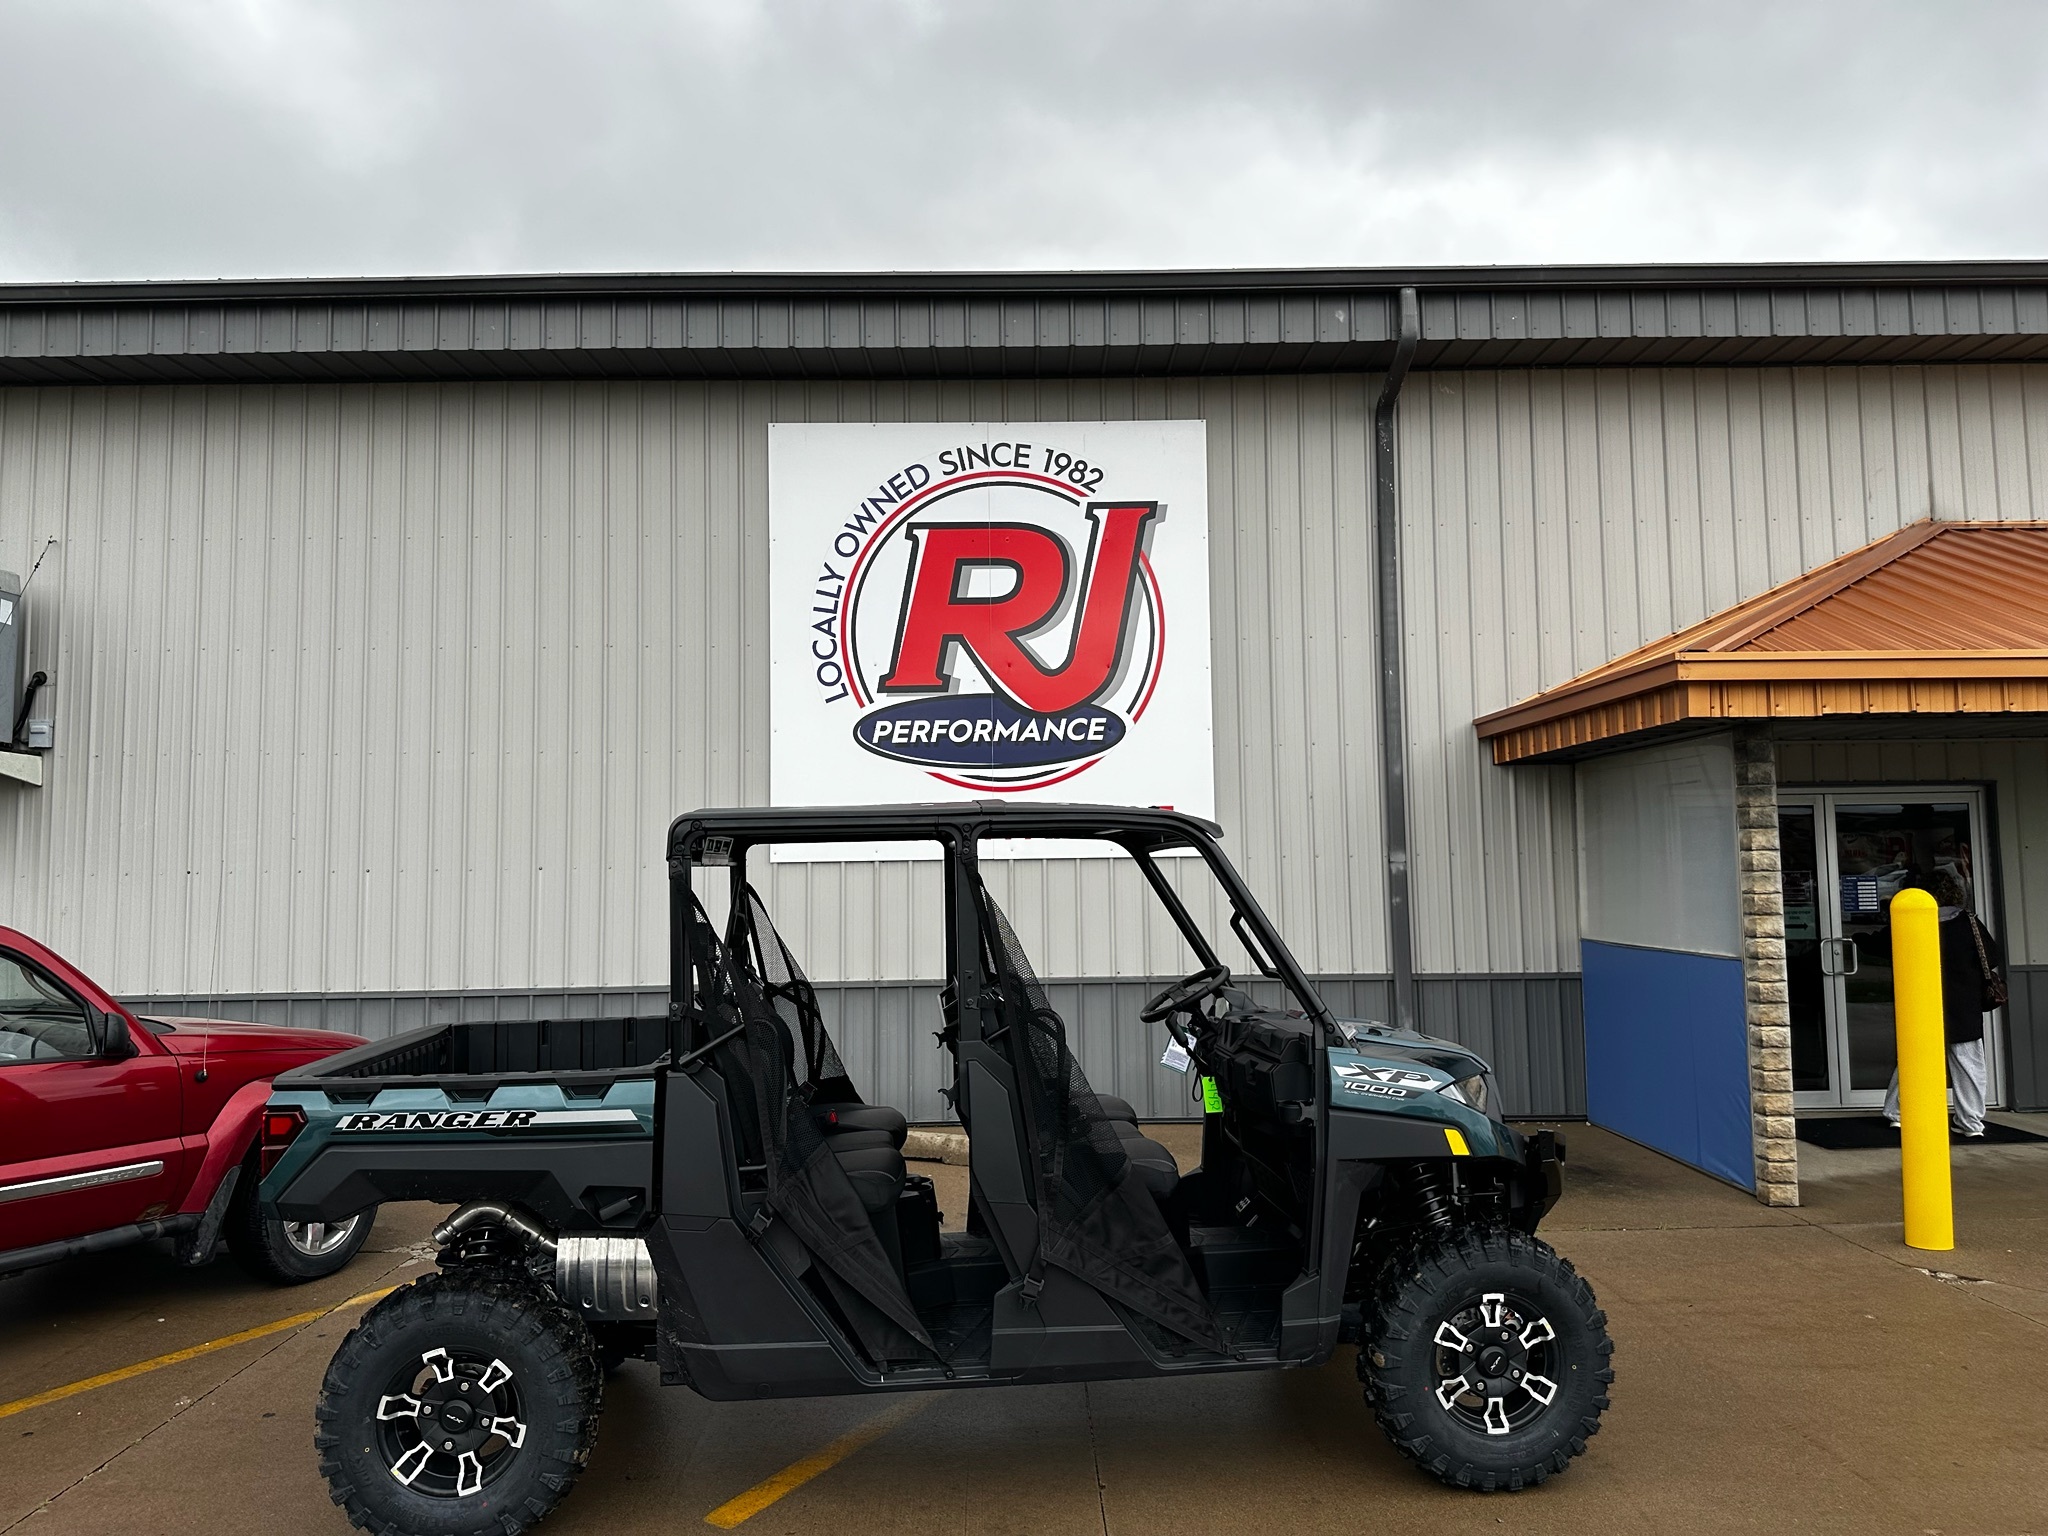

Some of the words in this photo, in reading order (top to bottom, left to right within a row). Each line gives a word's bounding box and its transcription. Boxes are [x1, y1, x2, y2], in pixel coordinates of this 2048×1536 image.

[811, 562, 849, 703] LOCALLY
[834, 463, 930, 557] OWNED
[938, 442, 1032, 476] SINCE
[1043, 448, 1104, 494] 1982
[877, 501, 1160, 718] RJ
[871, 717, 1108, 744] PERFORMANCE
[1342, 1062, 1433, 1084] XP
[1343, 1081, 1407, 1097] 1000
[342, 1110, 537, 1131] RANGER
